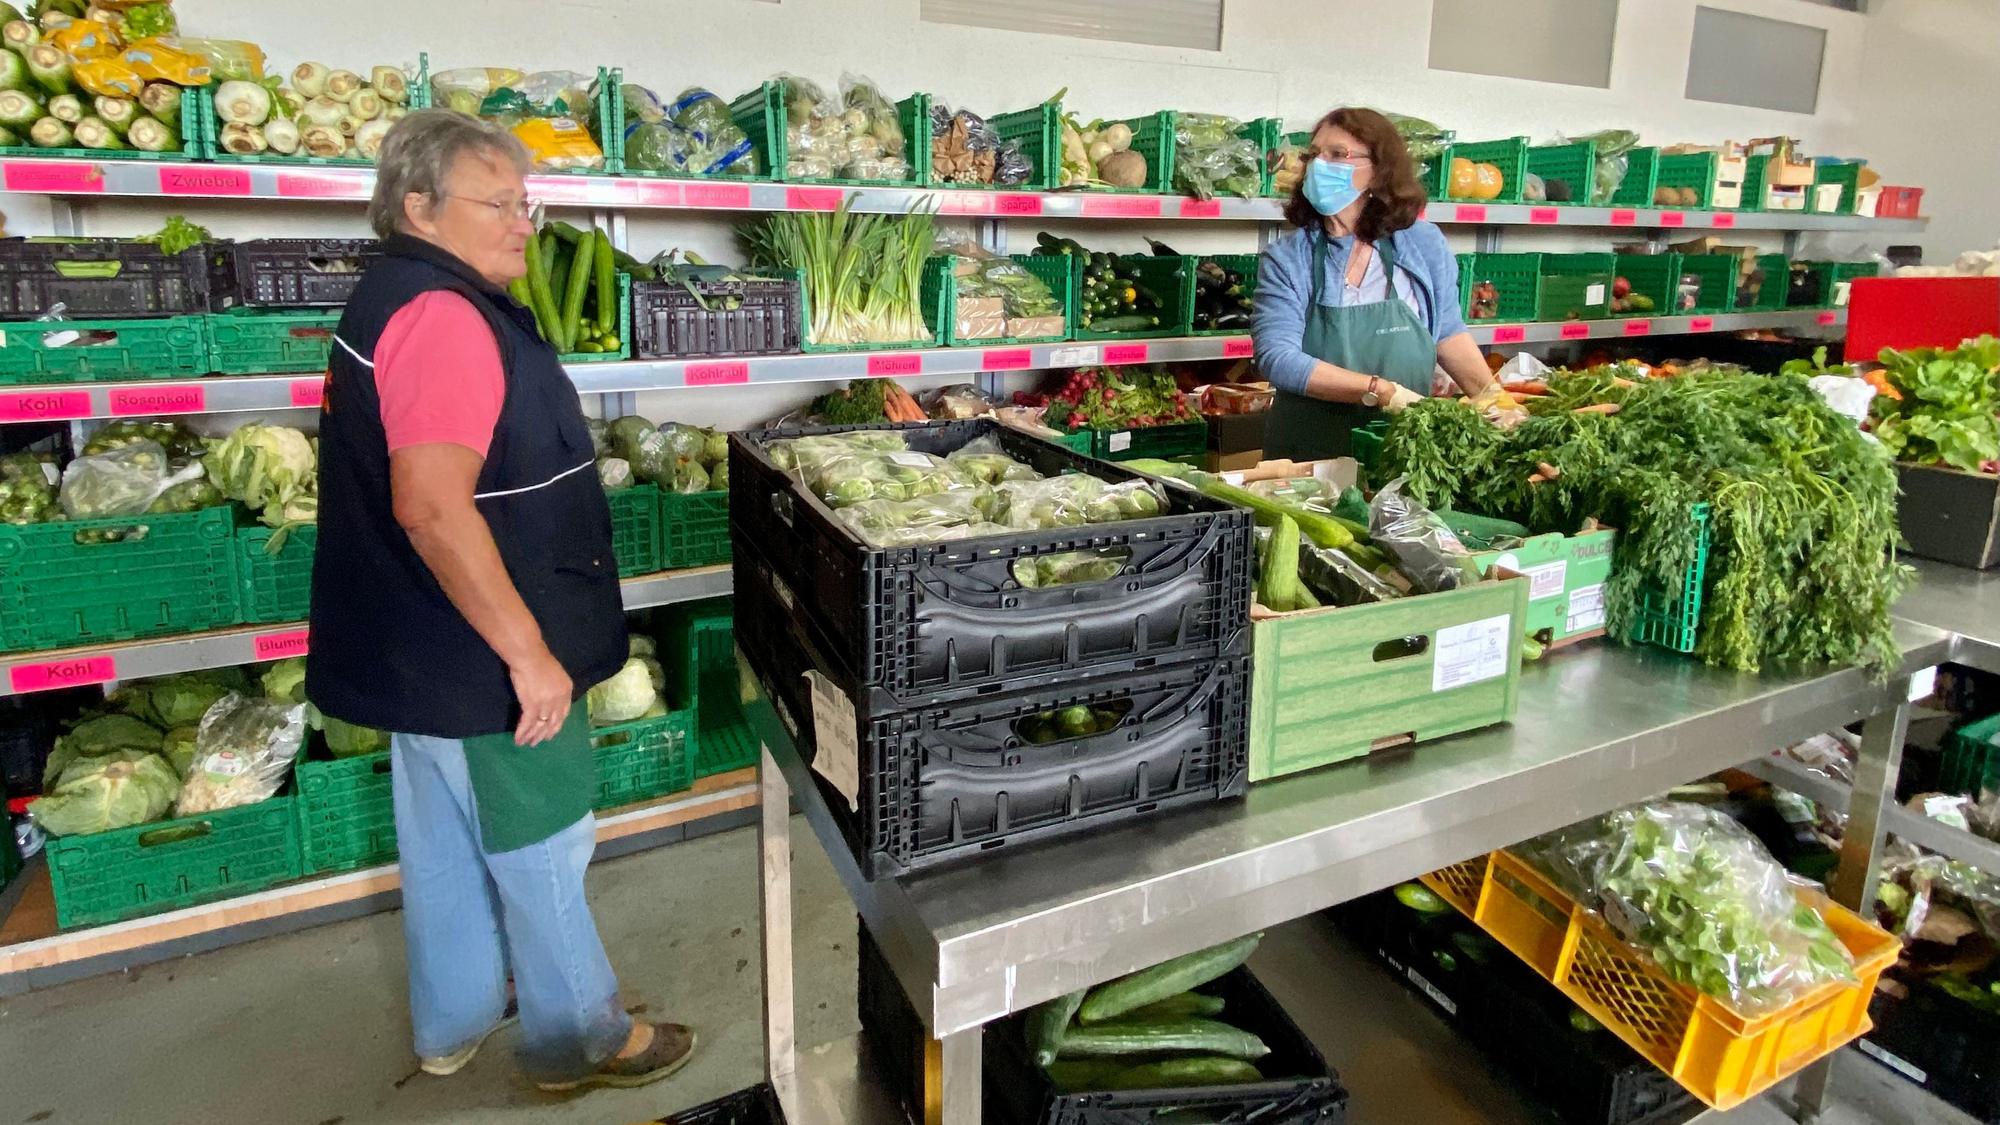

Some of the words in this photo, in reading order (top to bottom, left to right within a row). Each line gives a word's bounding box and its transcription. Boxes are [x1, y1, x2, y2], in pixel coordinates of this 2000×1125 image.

[172, 174, 241, 188] Zwiebel
[1001, 199, 1036, 212] Spargel
[873, 360, 915, 371] Möhren
[690, 366, 744, 380] Kohlrabi
[19, 395, 65, 411] Kohl
[117, 392, 200, 409] Rosenkohl
[47, 663, 93, 681] Kohl
